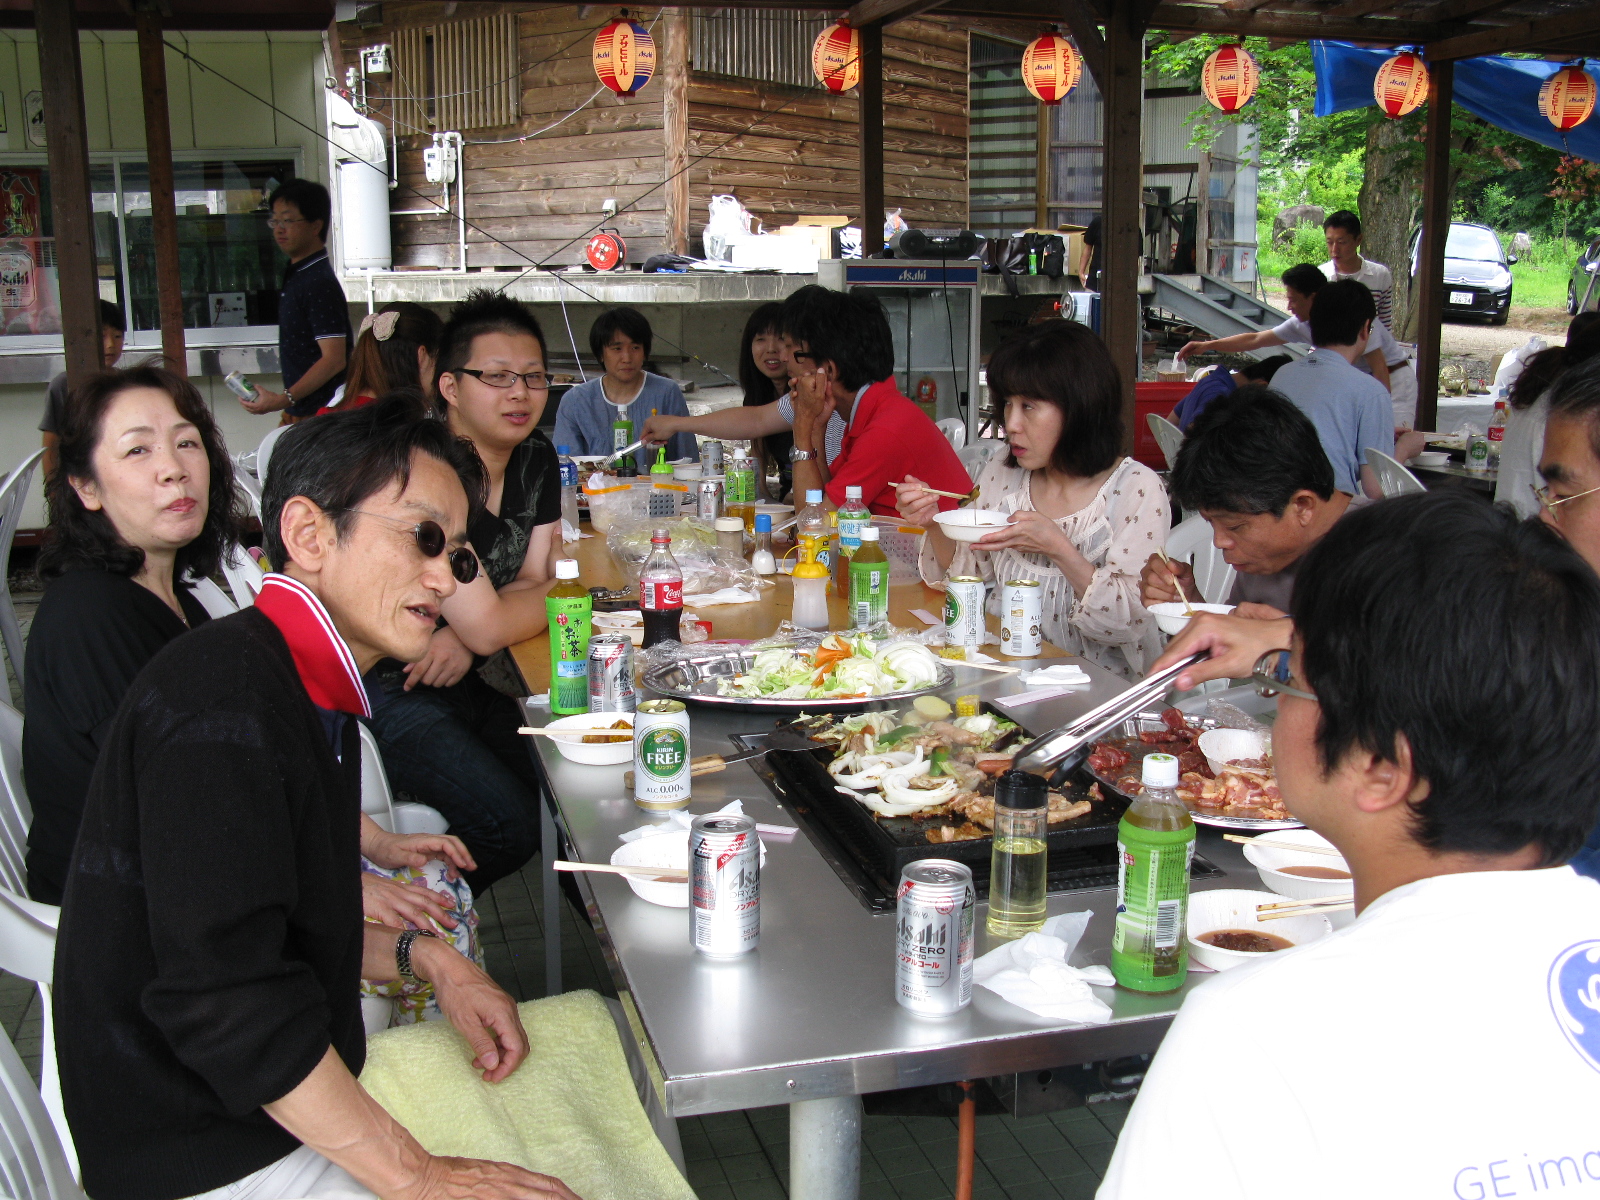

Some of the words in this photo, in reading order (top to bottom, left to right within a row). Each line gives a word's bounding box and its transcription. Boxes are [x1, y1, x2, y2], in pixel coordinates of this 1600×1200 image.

[596, 51, 610, 59] Asahi
[620, 35, 628, 75] アサヒビール
[825, 55, 844, 63] Asahi
[1061, 48, 1070, 87] アサヒビール
[1241, 59, 1249, 96] アサヒビール
[1389, 79, 1407, 87] Asahi
[1407, 70, 1423, 105] アサヒビール
[1551, 81, 1562, 116] アサヒビール
[0, 271, 29, 285] sahi
[898, 269, 926, 281] Asahi
[646, 751, 682, 765] FREE
[897, 916, 946, 946] Asahi
[911, 944, 946, 955] ZERO
[897, 953, 940, 969] ノンアルコール
[1453, 1160, 1516, 1200] GE
